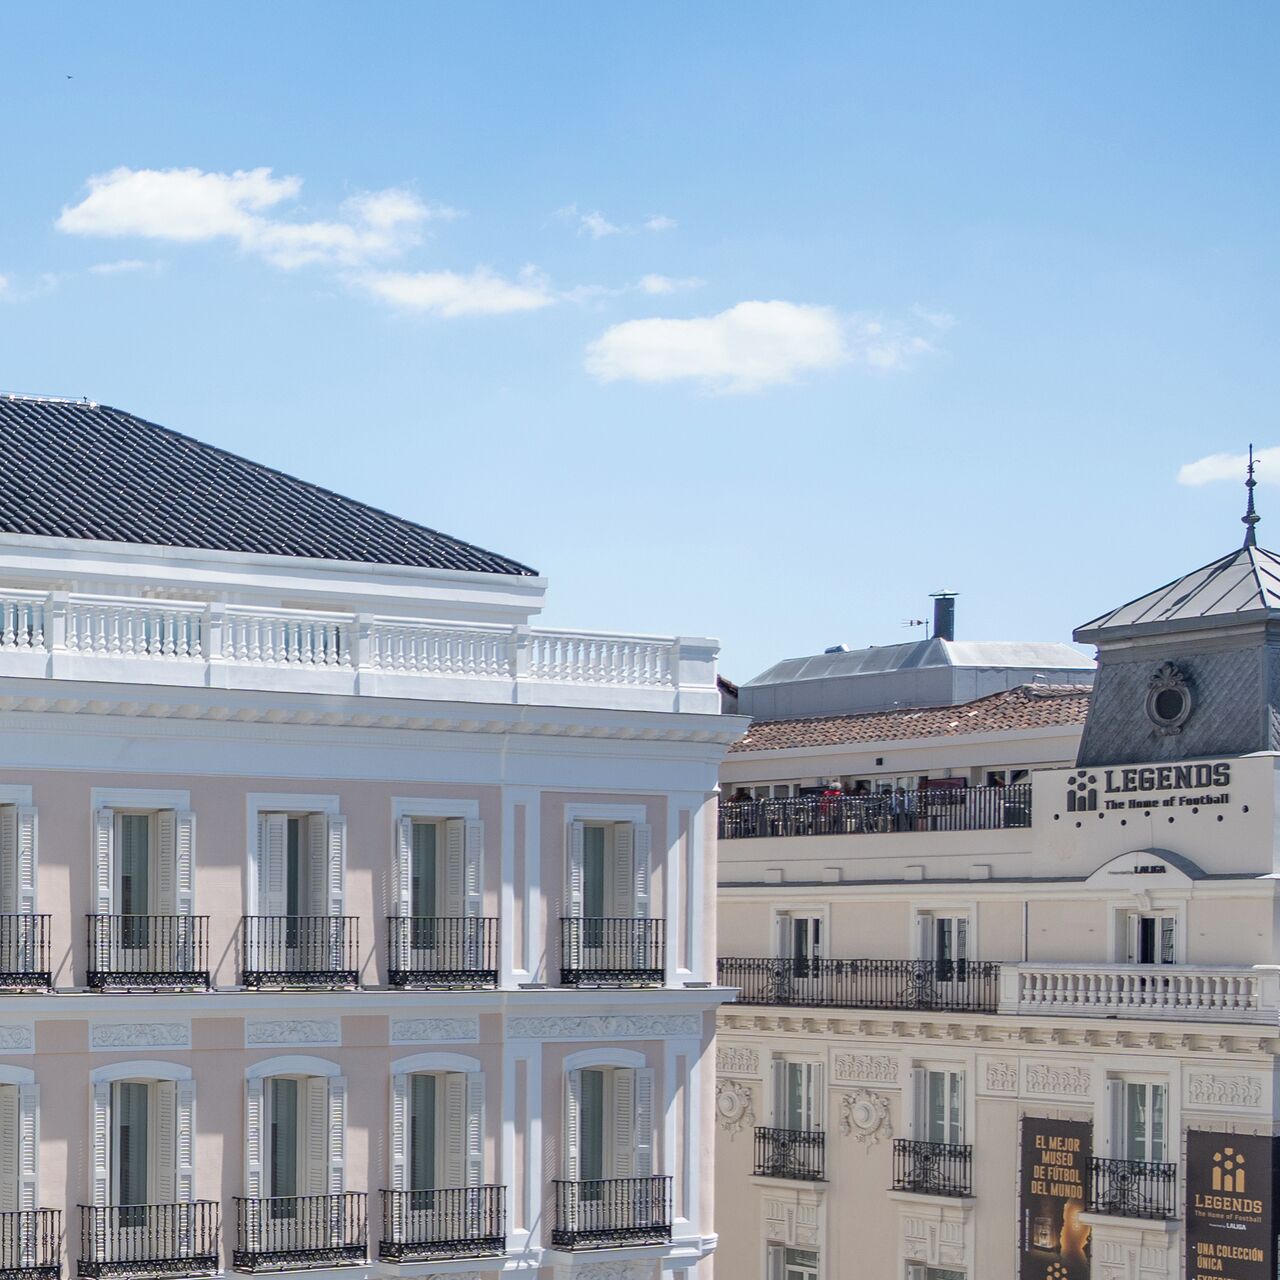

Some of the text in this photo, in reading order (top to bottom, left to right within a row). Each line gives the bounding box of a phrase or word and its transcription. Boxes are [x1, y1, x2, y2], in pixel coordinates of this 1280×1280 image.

[1104, 763, 1230, 793] LEGENDS
[1104, 793, 1229, 810] The Home of Football
[1134, 866, 1166, 874] LALIGA
[1036, 1135, 1080, 1152] EL MEJOR
[1042, 1150, 1073, 1166] MUSEO
[1034, 1165, 1081, 1183] DE FÚTBOL
[1031, 1180, 1083, 1199] DEL MUNDO
[1195, 1194, 1263, 1213] LEGENDS
[1208, 1211, 1224, 1219] Home
[1234, 1214, 1262, 1223] Football
[1197, 1242, 1264, 1262] UNA COLECCIÓN
[1197, 1255, 1223, 1271] ÚNICA
